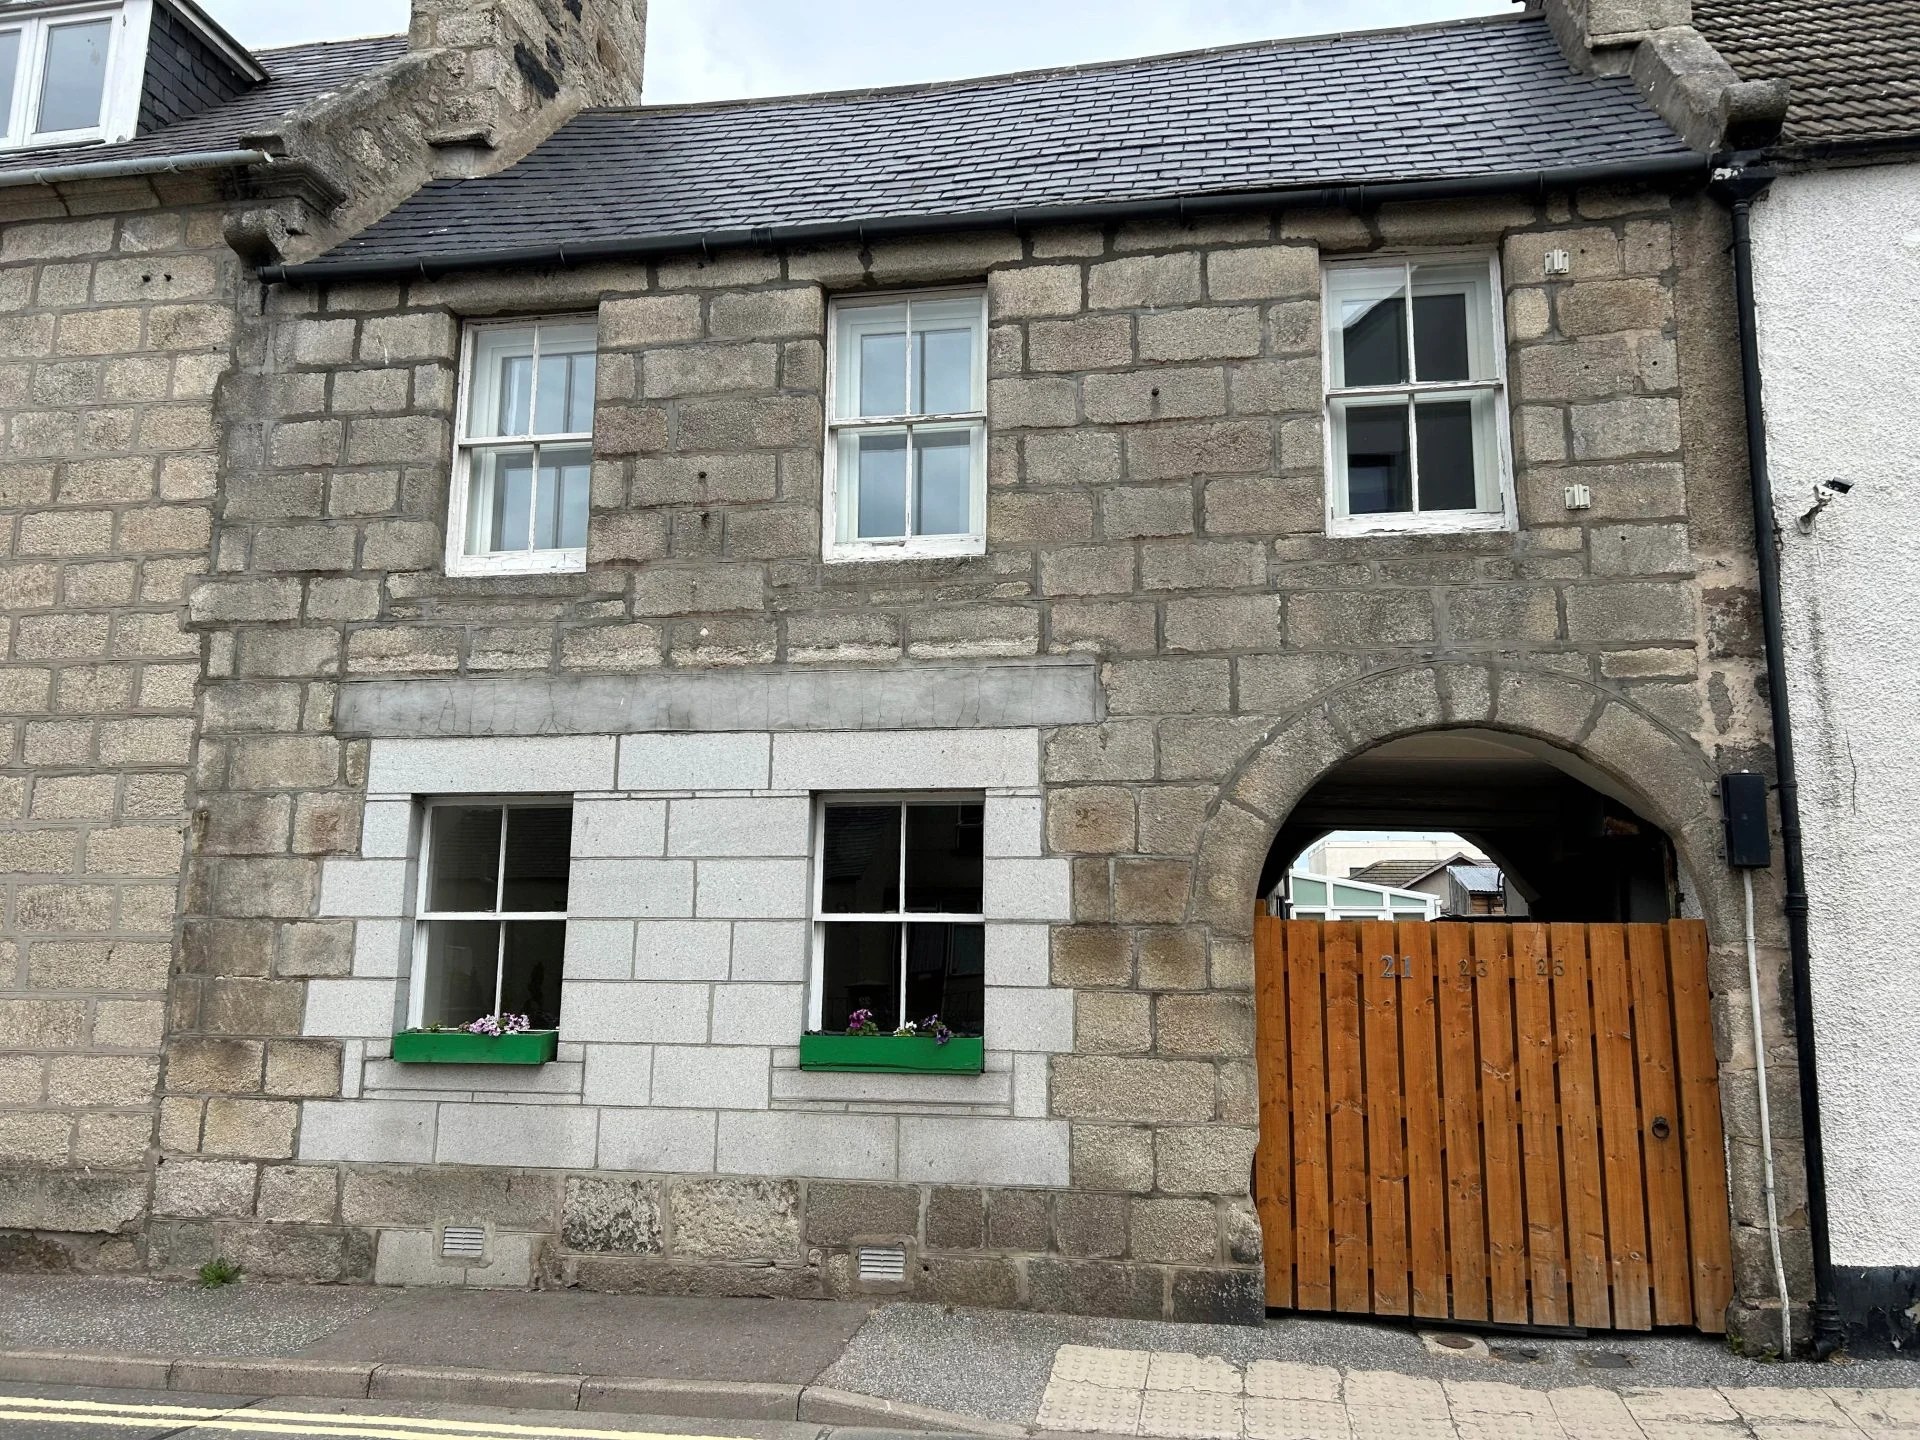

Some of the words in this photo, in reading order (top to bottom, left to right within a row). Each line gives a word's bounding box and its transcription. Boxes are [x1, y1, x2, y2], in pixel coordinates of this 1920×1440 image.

[1379, 954, 1413, 978] 21
[1457, 959, 1488, 977] 23
[1536, 959, 1565, 976] 25
